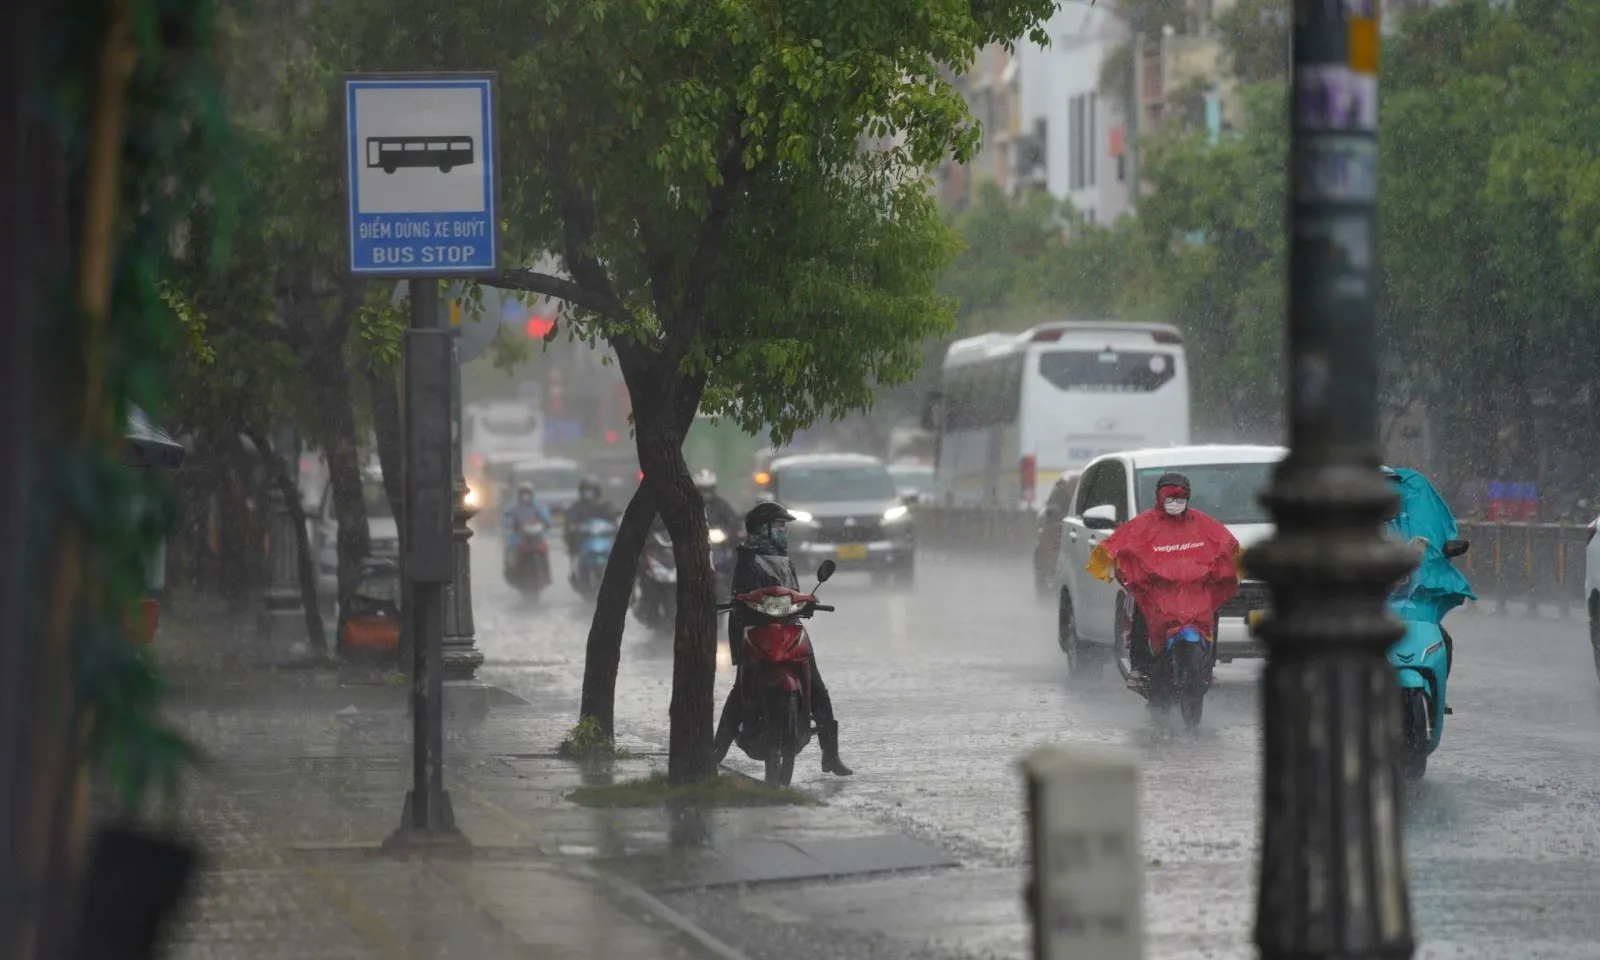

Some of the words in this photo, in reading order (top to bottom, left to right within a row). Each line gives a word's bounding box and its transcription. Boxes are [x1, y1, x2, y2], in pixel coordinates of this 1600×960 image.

[359, 216, 391, 239] ĐIỂM
[395, 217, 430, 238] DỪNG
[434, 221, 451, 238] XE
[453, 216, 486, 237] BUÝT
[373, 246, 415, 264] BUS
[421, 245, 475, 263] STOP
